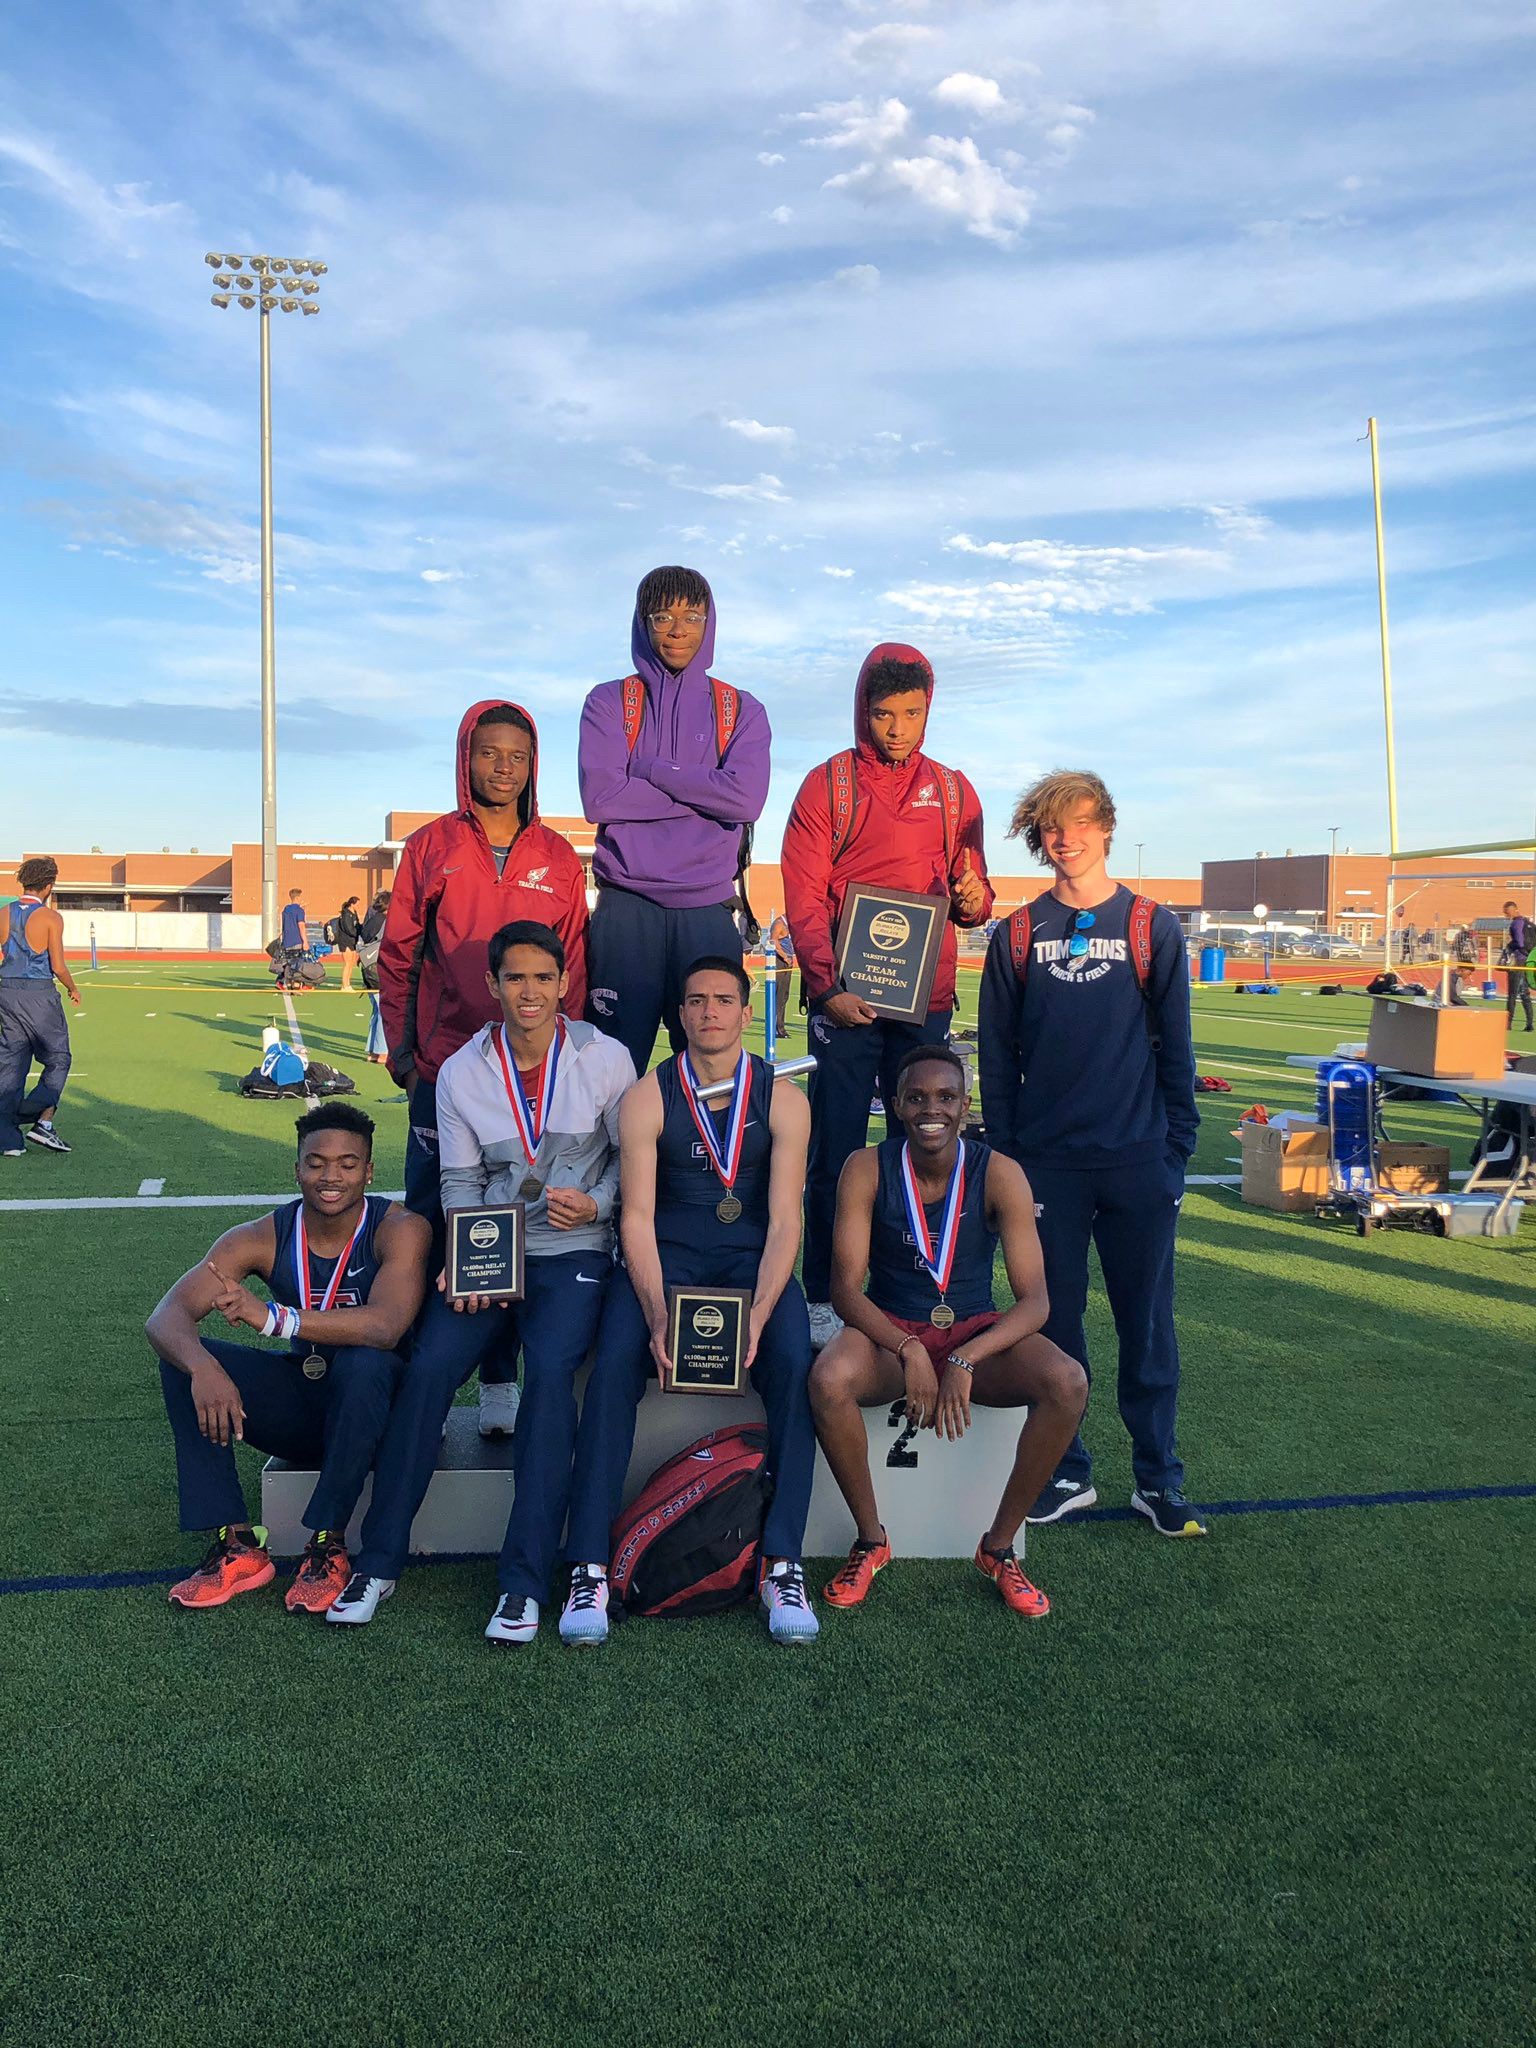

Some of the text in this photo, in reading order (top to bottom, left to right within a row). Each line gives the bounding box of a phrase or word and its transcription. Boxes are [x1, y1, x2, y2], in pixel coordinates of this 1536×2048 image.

[721, 689, 733, 726] TRACK
[912, 800, 928, 808] TRACK
[518, 880, 536, 889] TRACK
[540, 885, 554, 894] FIELD
[1136, 919, 1150, 970] FIELD
[862, 952, 907, 965] VARSITY BOYS
[865, 964, 897, 977] TEAM
[1047, 961, 1112, 983] TRACK & FIELD
[850, 971, 908, 988] CHAMPION
[870, 988, 883, 996] 2020
[467, 1269, 502, 1277] CHAMPION
[688, 1361, 724, 1369] CHAMPION
[886, 1399, 919, 1468] 2
[614, 1480, 708, 1580] TRACK & FIELD
